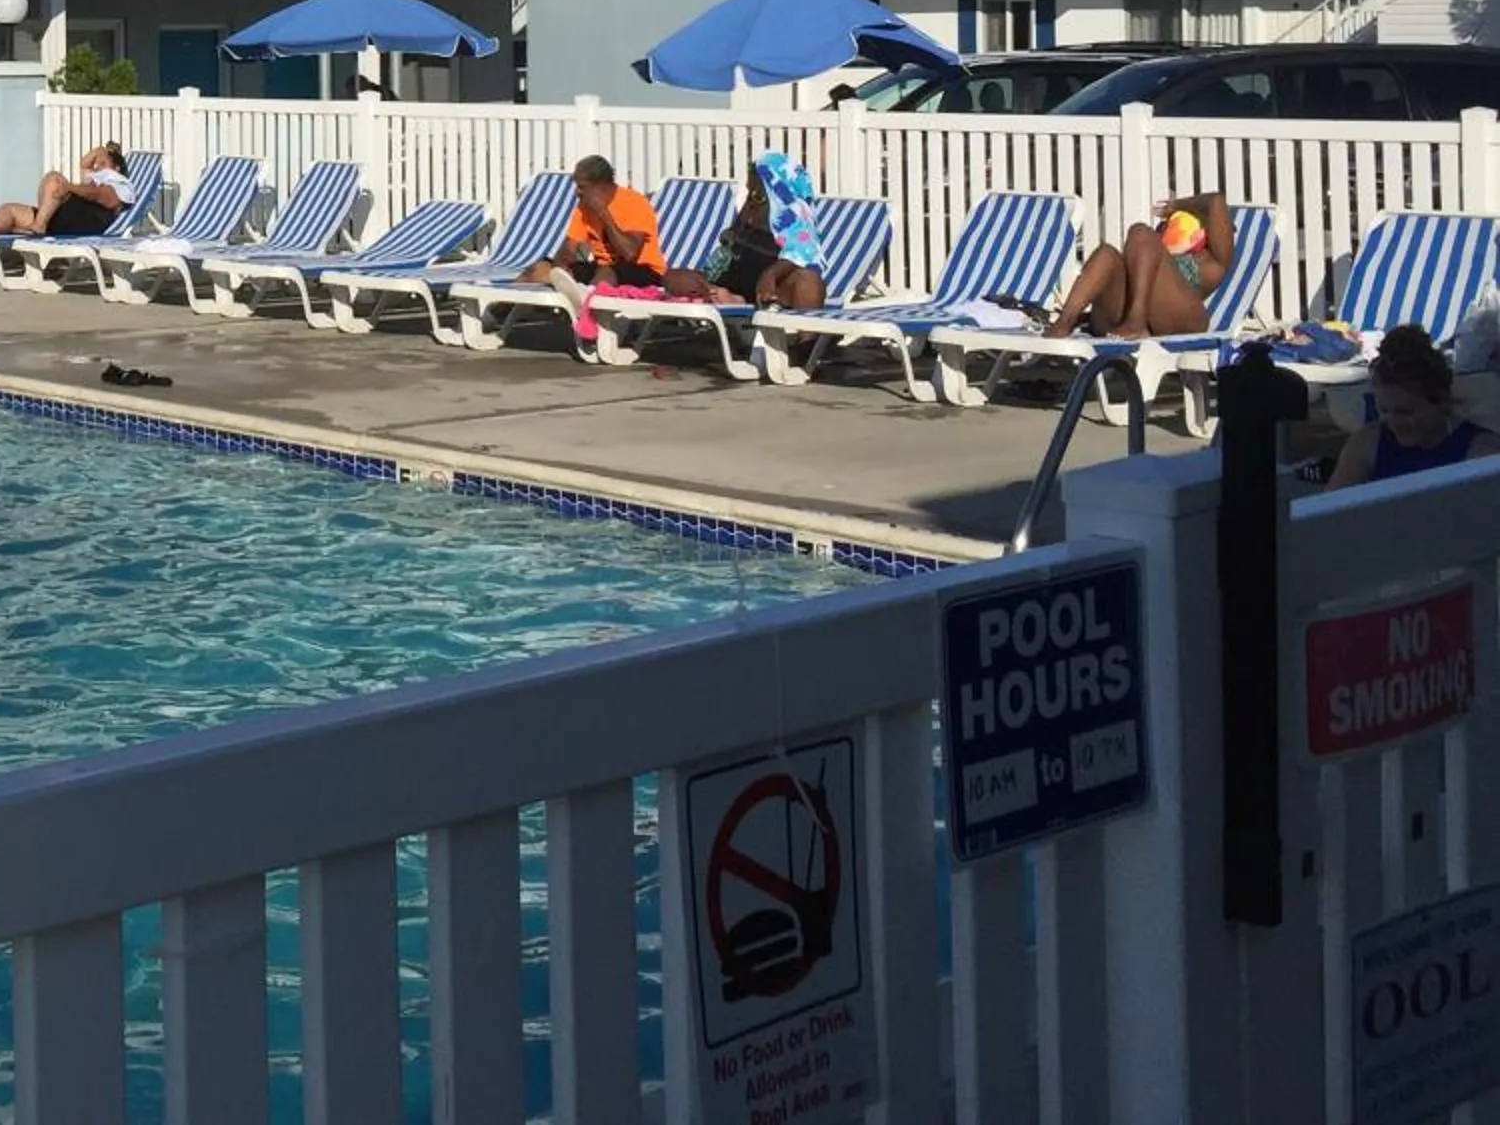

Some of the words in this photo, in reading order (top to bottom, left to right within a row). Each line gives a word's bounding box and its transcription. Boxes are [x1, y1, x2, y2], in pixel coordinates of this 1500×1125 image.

[979, 586, 1112, 668] POOL
[1387, 609, 1431, 665] NO
[960, 645, 1132, 741] HOURS
[1329, 648, 1467, 735] SMOKING
[1040, 755, 1065, 786] to
[1361, 947, 1494, 1041] OOL
[713, 1053, 739, 1086] No
[741, 1030, 785, 1070] Food
[787, 1026, 807, 1050] or
[745, 1050, 812, 1106] Allowed
[814, 1049, 832, 1073] in
[791, 1083, 832, 1116] Area
